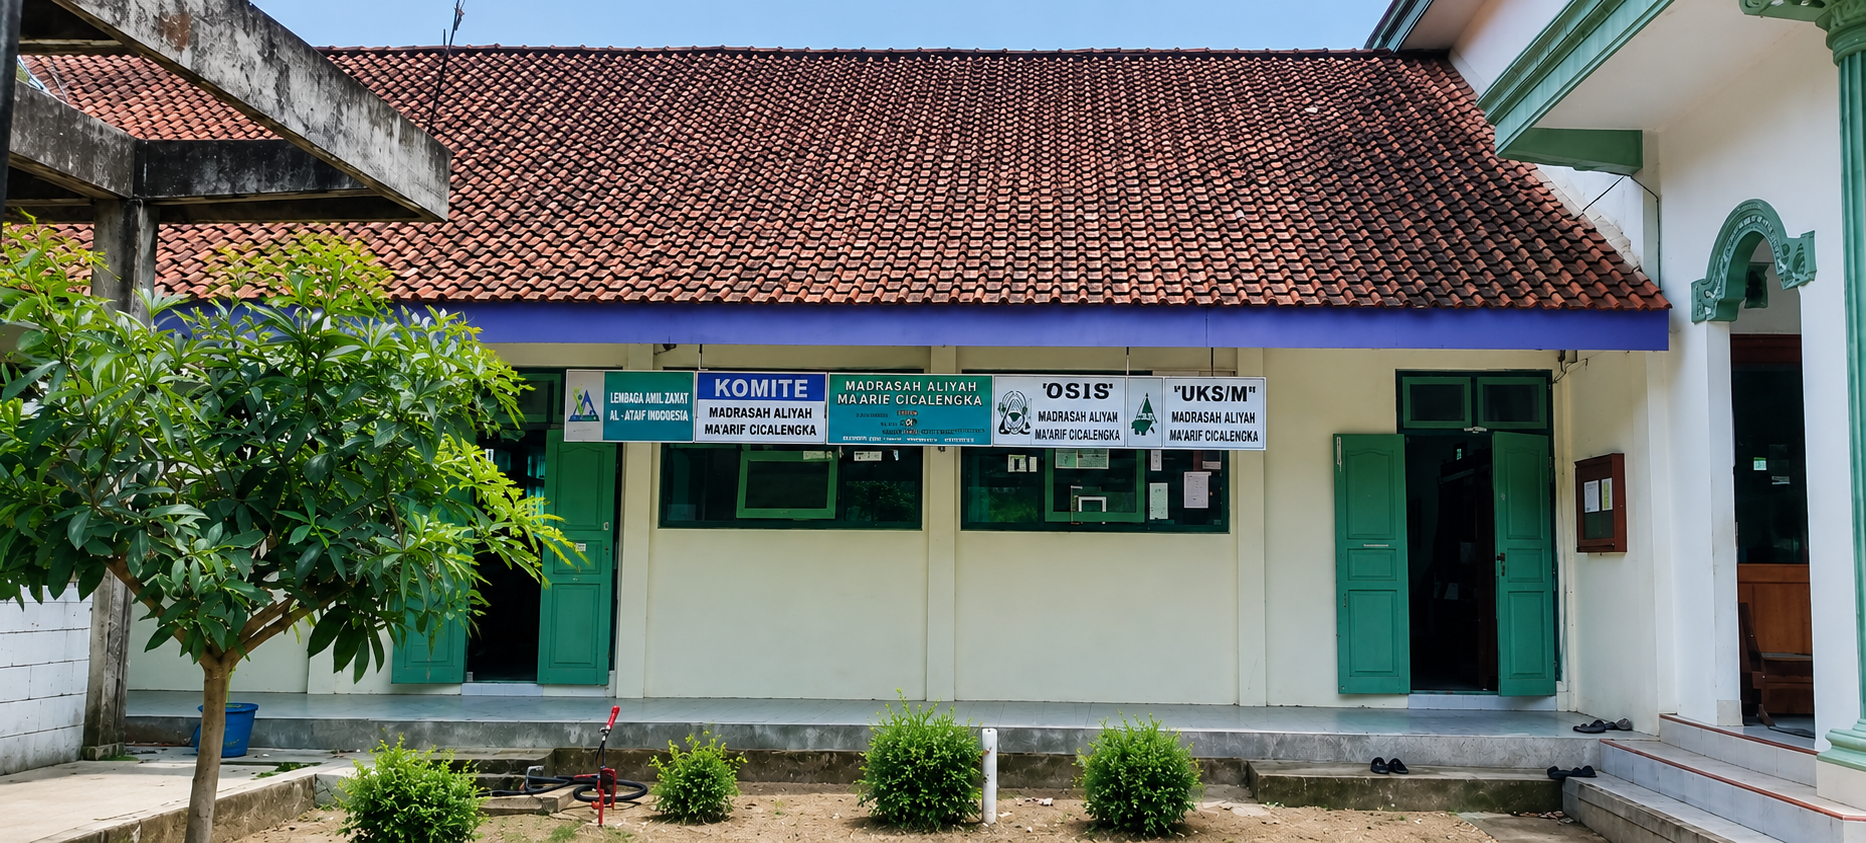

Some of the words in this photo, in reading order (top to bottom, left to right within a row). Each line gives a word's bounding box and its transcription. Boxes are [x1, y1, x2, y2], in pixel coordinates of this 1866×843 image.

[715, 379, 808, 398] KOMITE
[846, 381, 921, 391] MADRASAH
[927, 382, 976, 392] ALIYAH
[610, 392, 643, 403] LEMBAGA
[896, 395, 982, 406] CICALENGKA
[709, 407, 770, 418] MADRASAH
[774, 408, 812, 419] ALIYAH
[1038, 411, 1086, 422] MADRASAH
[1089, 412, 1118, 422] ALIYAH
[1172, 412, 1221, 423] MADRASAH
[1224, 412, 1255, 423] ALIYAH
[705, 424, 746, 435] MA'ARIF
[750, 425, 817, 435] CICALENGKA
[1035, 429, 1067, 440] MA'ARIF
[1069, 429, 1120, 440] CICALENGKA
[1169, 430, 1203, 441] MA'ARIF
[1205, 430, 1258, 442] CICALENGKA
